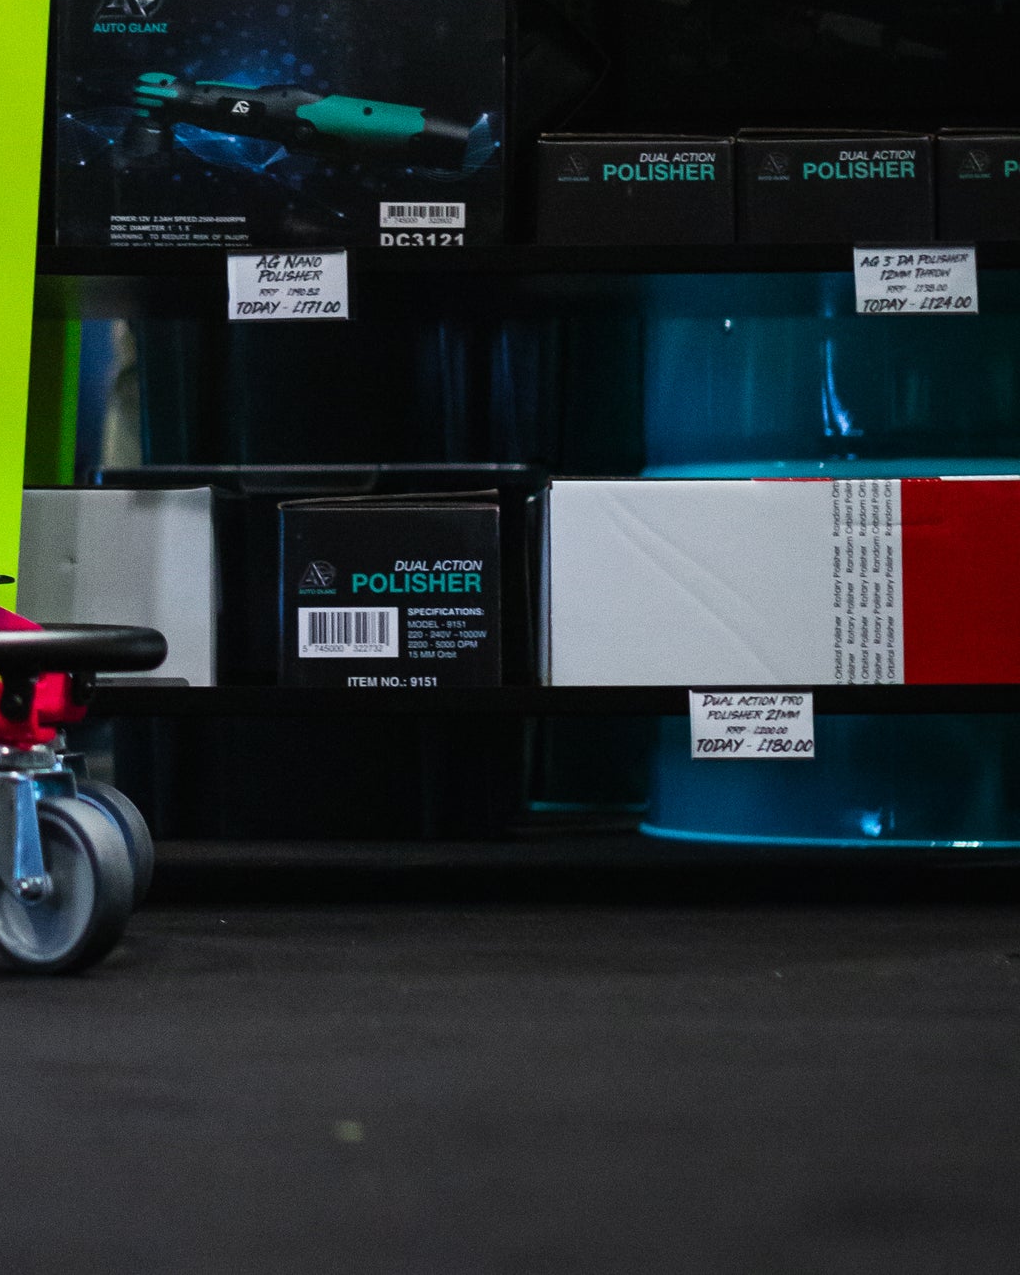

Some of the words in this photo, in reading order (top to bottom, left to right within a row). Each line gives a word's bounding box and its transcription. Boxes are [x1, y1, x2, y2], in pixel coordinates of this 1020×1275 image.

[93, 23, 127, 33] AUTO
[129, 23, 169, 33] GLANZ
[640, 153, 670, 163] DUAL
[673, 152, 717, 162] ACTION
[839, 151, 870, 161] DUAL
[873, 150, 916, 160] ACTION
[603, 164, 715, 181] POLISHER
[803, 161, 915, 180] POLISHER
[380, 233, 464, 246] DC3121
[256, 255, 280, 269] AG
[283, 255, 323, 269] NANO
[860, 256, 879, 267] AG
[897, 255, 914, 266] DA
[258, 270, 323, 283] POLISHER
[237, 301, 281, 315] TODAY
[863, 298, 907, 312] TODAY
[832, 500, 840, 536] Random
[845, 505, 853, 534] Orbital
[859, 500, 867, 536] Random
[871, 505, 879, 534] Orbital
[884, 500, 892, 536] Random
[394, 560, 430, 572] DUAL
[433, 560, 483, 571] ACTION
[845, 536, 853, 573] Random
[872, 536, 880, 573] Random
[885, 546, 893, 577] Polisher
[352, 573, 481, 593] POLISHER
[833, 580, 842, 607] Rotary
[860, 580, 869, 607] Rotary
[886, 580, 895, 607] Rotary
[846, 583, 854, 614] Polisher
[873, 583, 881, 614] Polisher
[407, 607, 485, 616] SPECIFICATIONS:
[407, 620, 440, 628] MODEL
[446, 620, 466, 628] 9151
[408, 630, 423, 639] 220
[834, 617, 842, 648] Polisher
[846, 616, 856, 644] Rotary
[860, 617, 869, 648] Polisher
[873, 616, 883, 644] Rotary
[886, 616, 895, 647] Polisher
[457, 640, 478, 649] OPM
[834, 650, 842, 679] Orbital
[861, 650, 869, 679] Orbital
[887, 650, 895, 678] Orbital
[348, 677, 378, 687] ITEM
[381, 677, 407, 687] NO.:
[410, 677, 438, 687] 9151
[702, 694, 733, 707] DUAL
[738, 695, 778, 706] ACTION
[781, 695, 804, 706] PRO
[707, 710, 764, 720] POLISHER
[696, 738, 744, 753] TODAY
